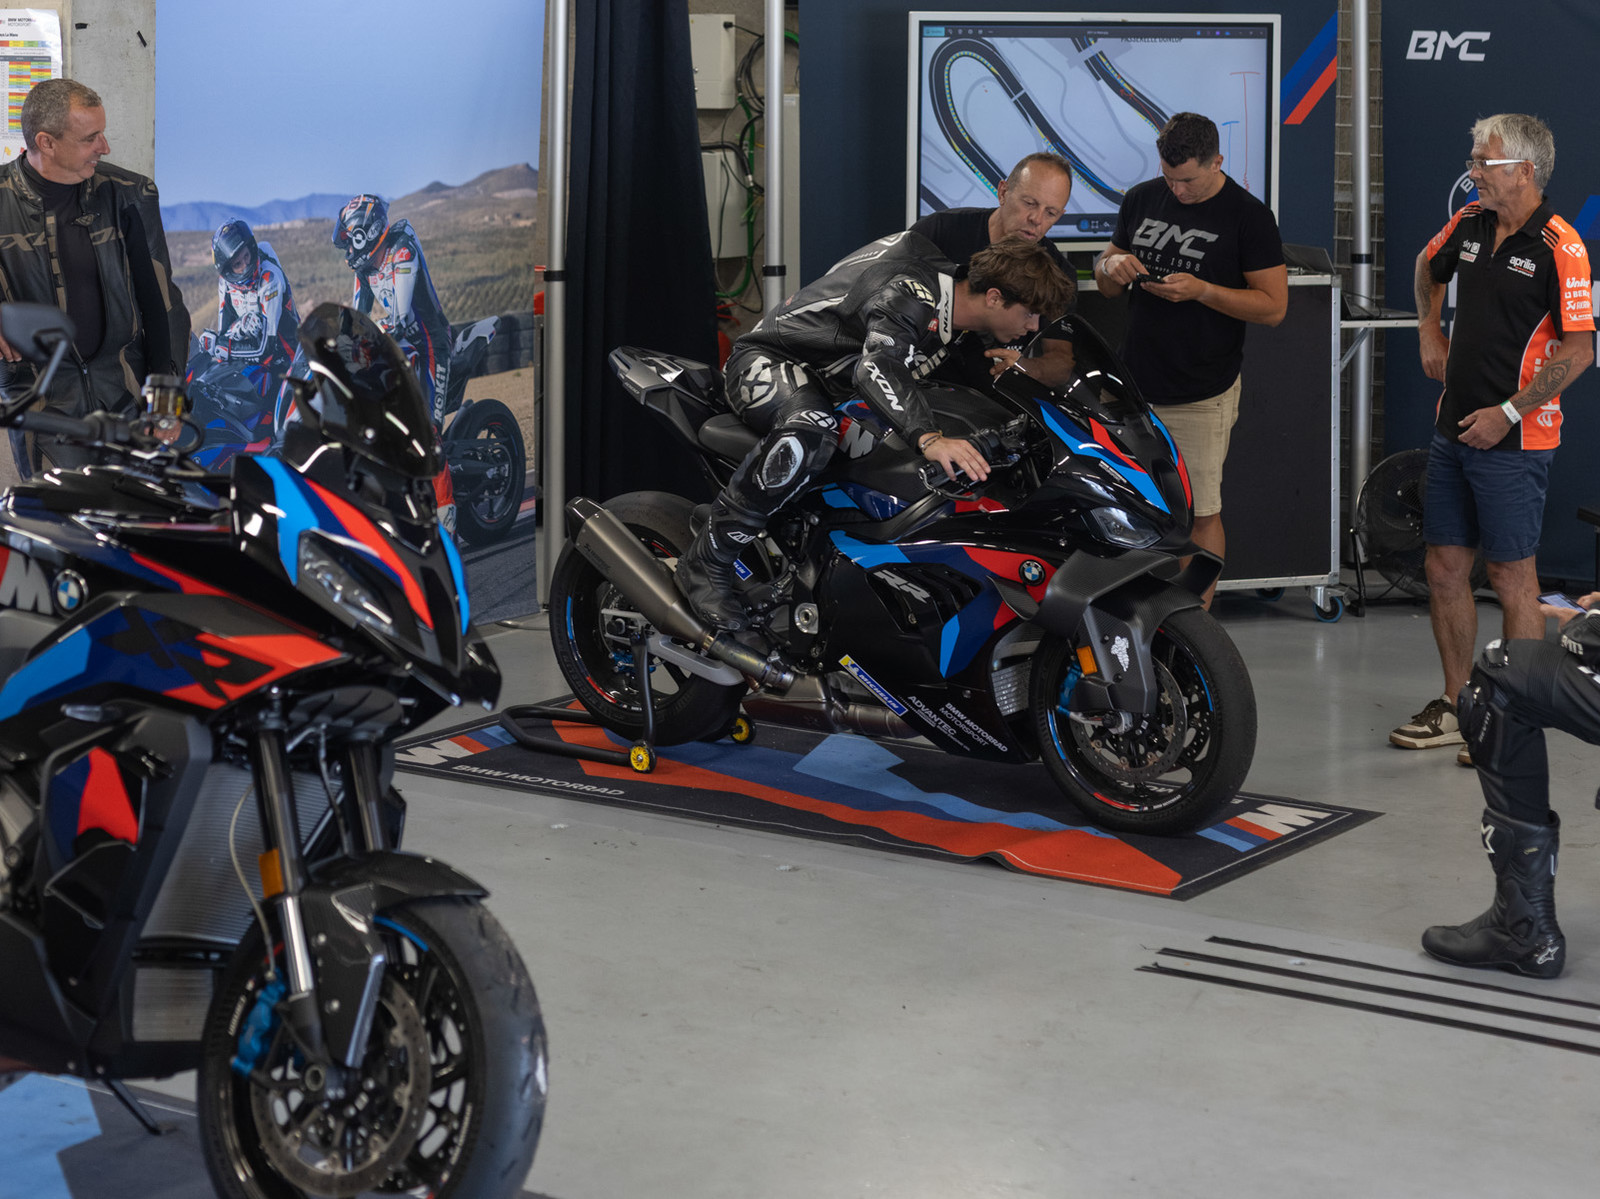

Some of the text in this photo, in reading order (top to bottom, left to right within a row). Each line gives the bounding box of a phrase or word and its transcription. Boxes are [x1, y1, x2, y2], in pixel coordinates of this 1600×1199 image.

[1405, 30, 1491, 62] BMC
[1132, 218, 1219, 260] BMC
[1170, 258, 1201, 272] 1998
[1509, 256, 1537, 273] aprilia
[858, 673, 900, 710] MICHELIN
[907, 695, 957, 736] ADVANTEC
[938, 707, 990, 747] MOTORSPORT
[945, 702, 969, 724] BMW
[966, 718, 1008, 752] MOTORRAD
[451, 764, 625, 797] BMW MOTORRAD
